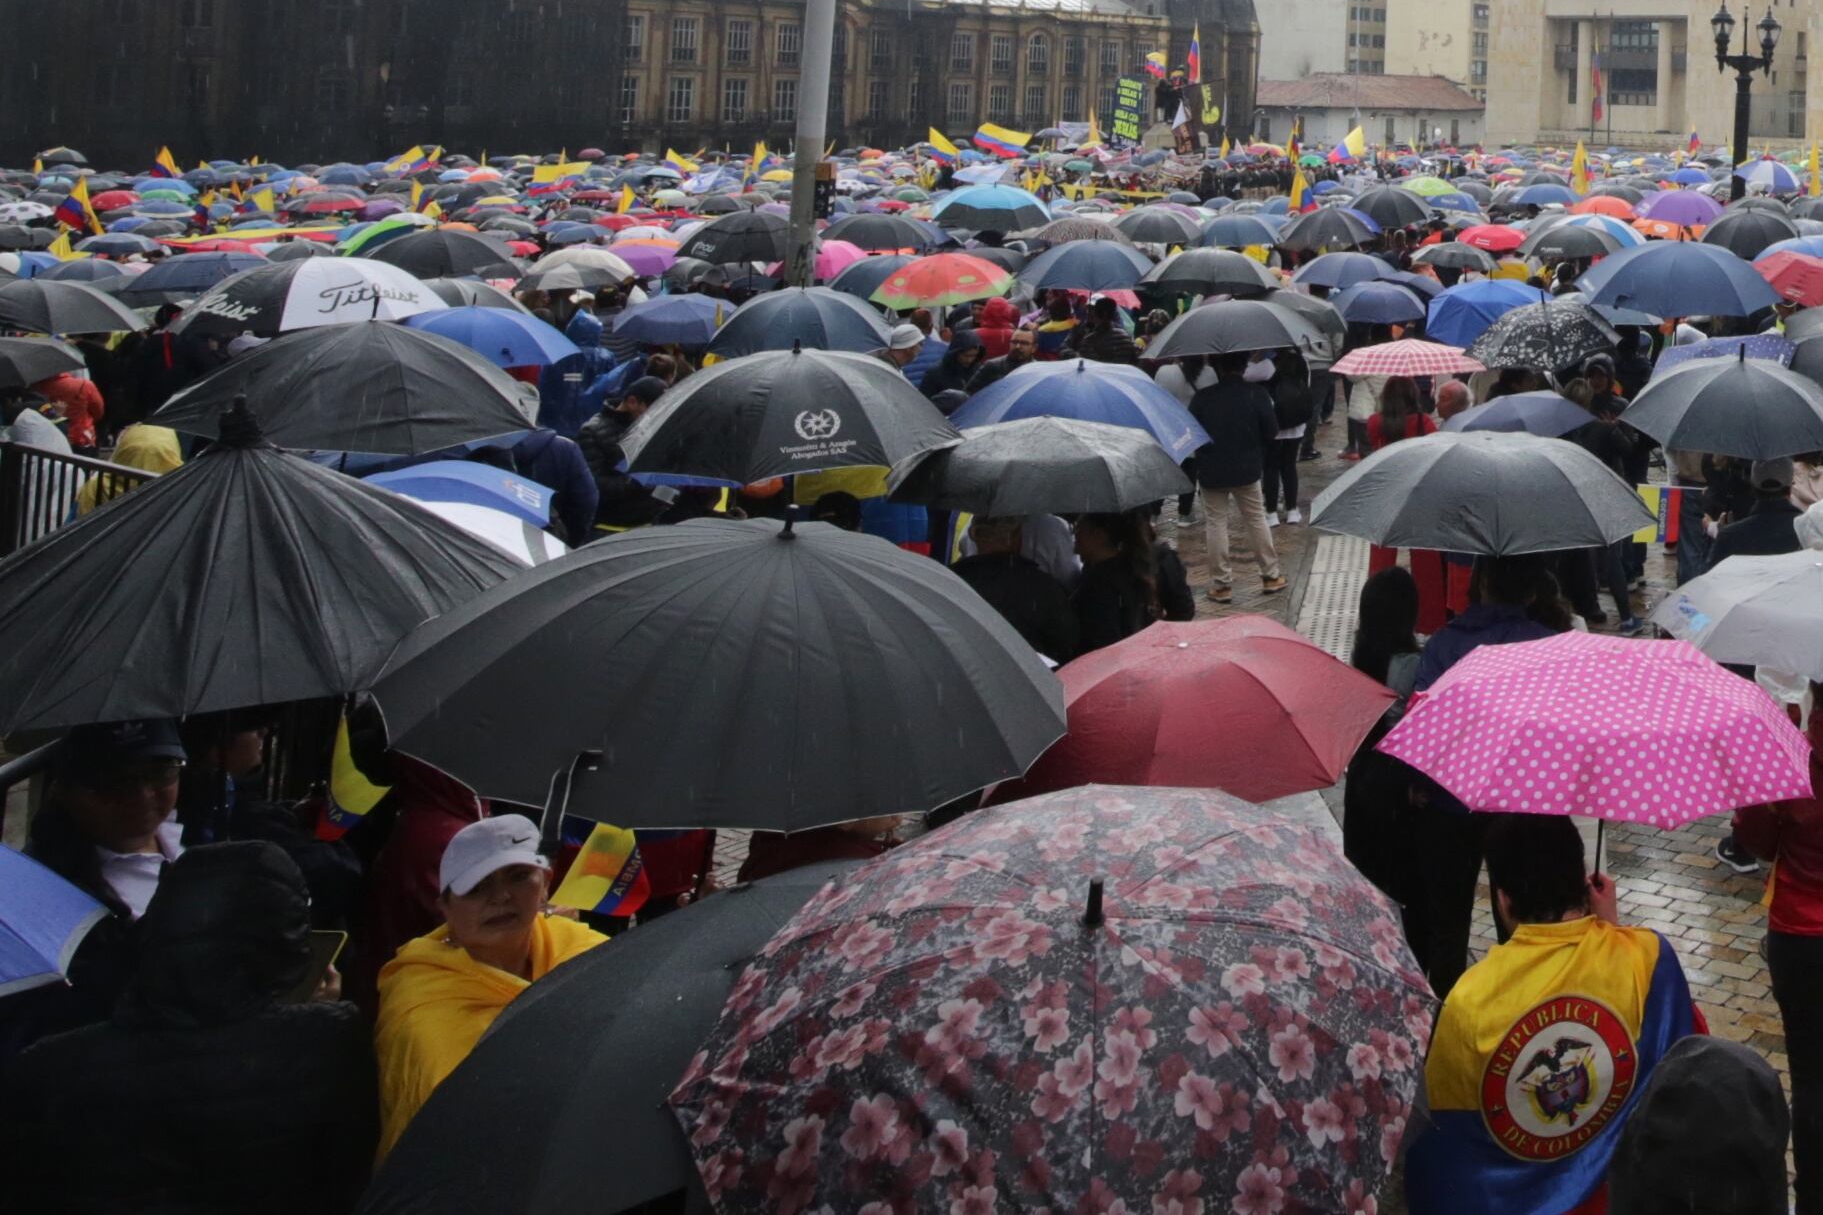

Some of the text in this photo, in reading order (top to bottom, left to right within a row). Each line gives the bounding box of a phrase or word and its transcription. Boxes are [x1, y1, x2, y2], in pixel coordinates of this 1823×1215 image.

[318, 280, 419, 314] Titleist
[1491, 1002, 1600, 1077] REPUBLICA
[1504, 1079, 1629, 1154] DE COLOMBIA
